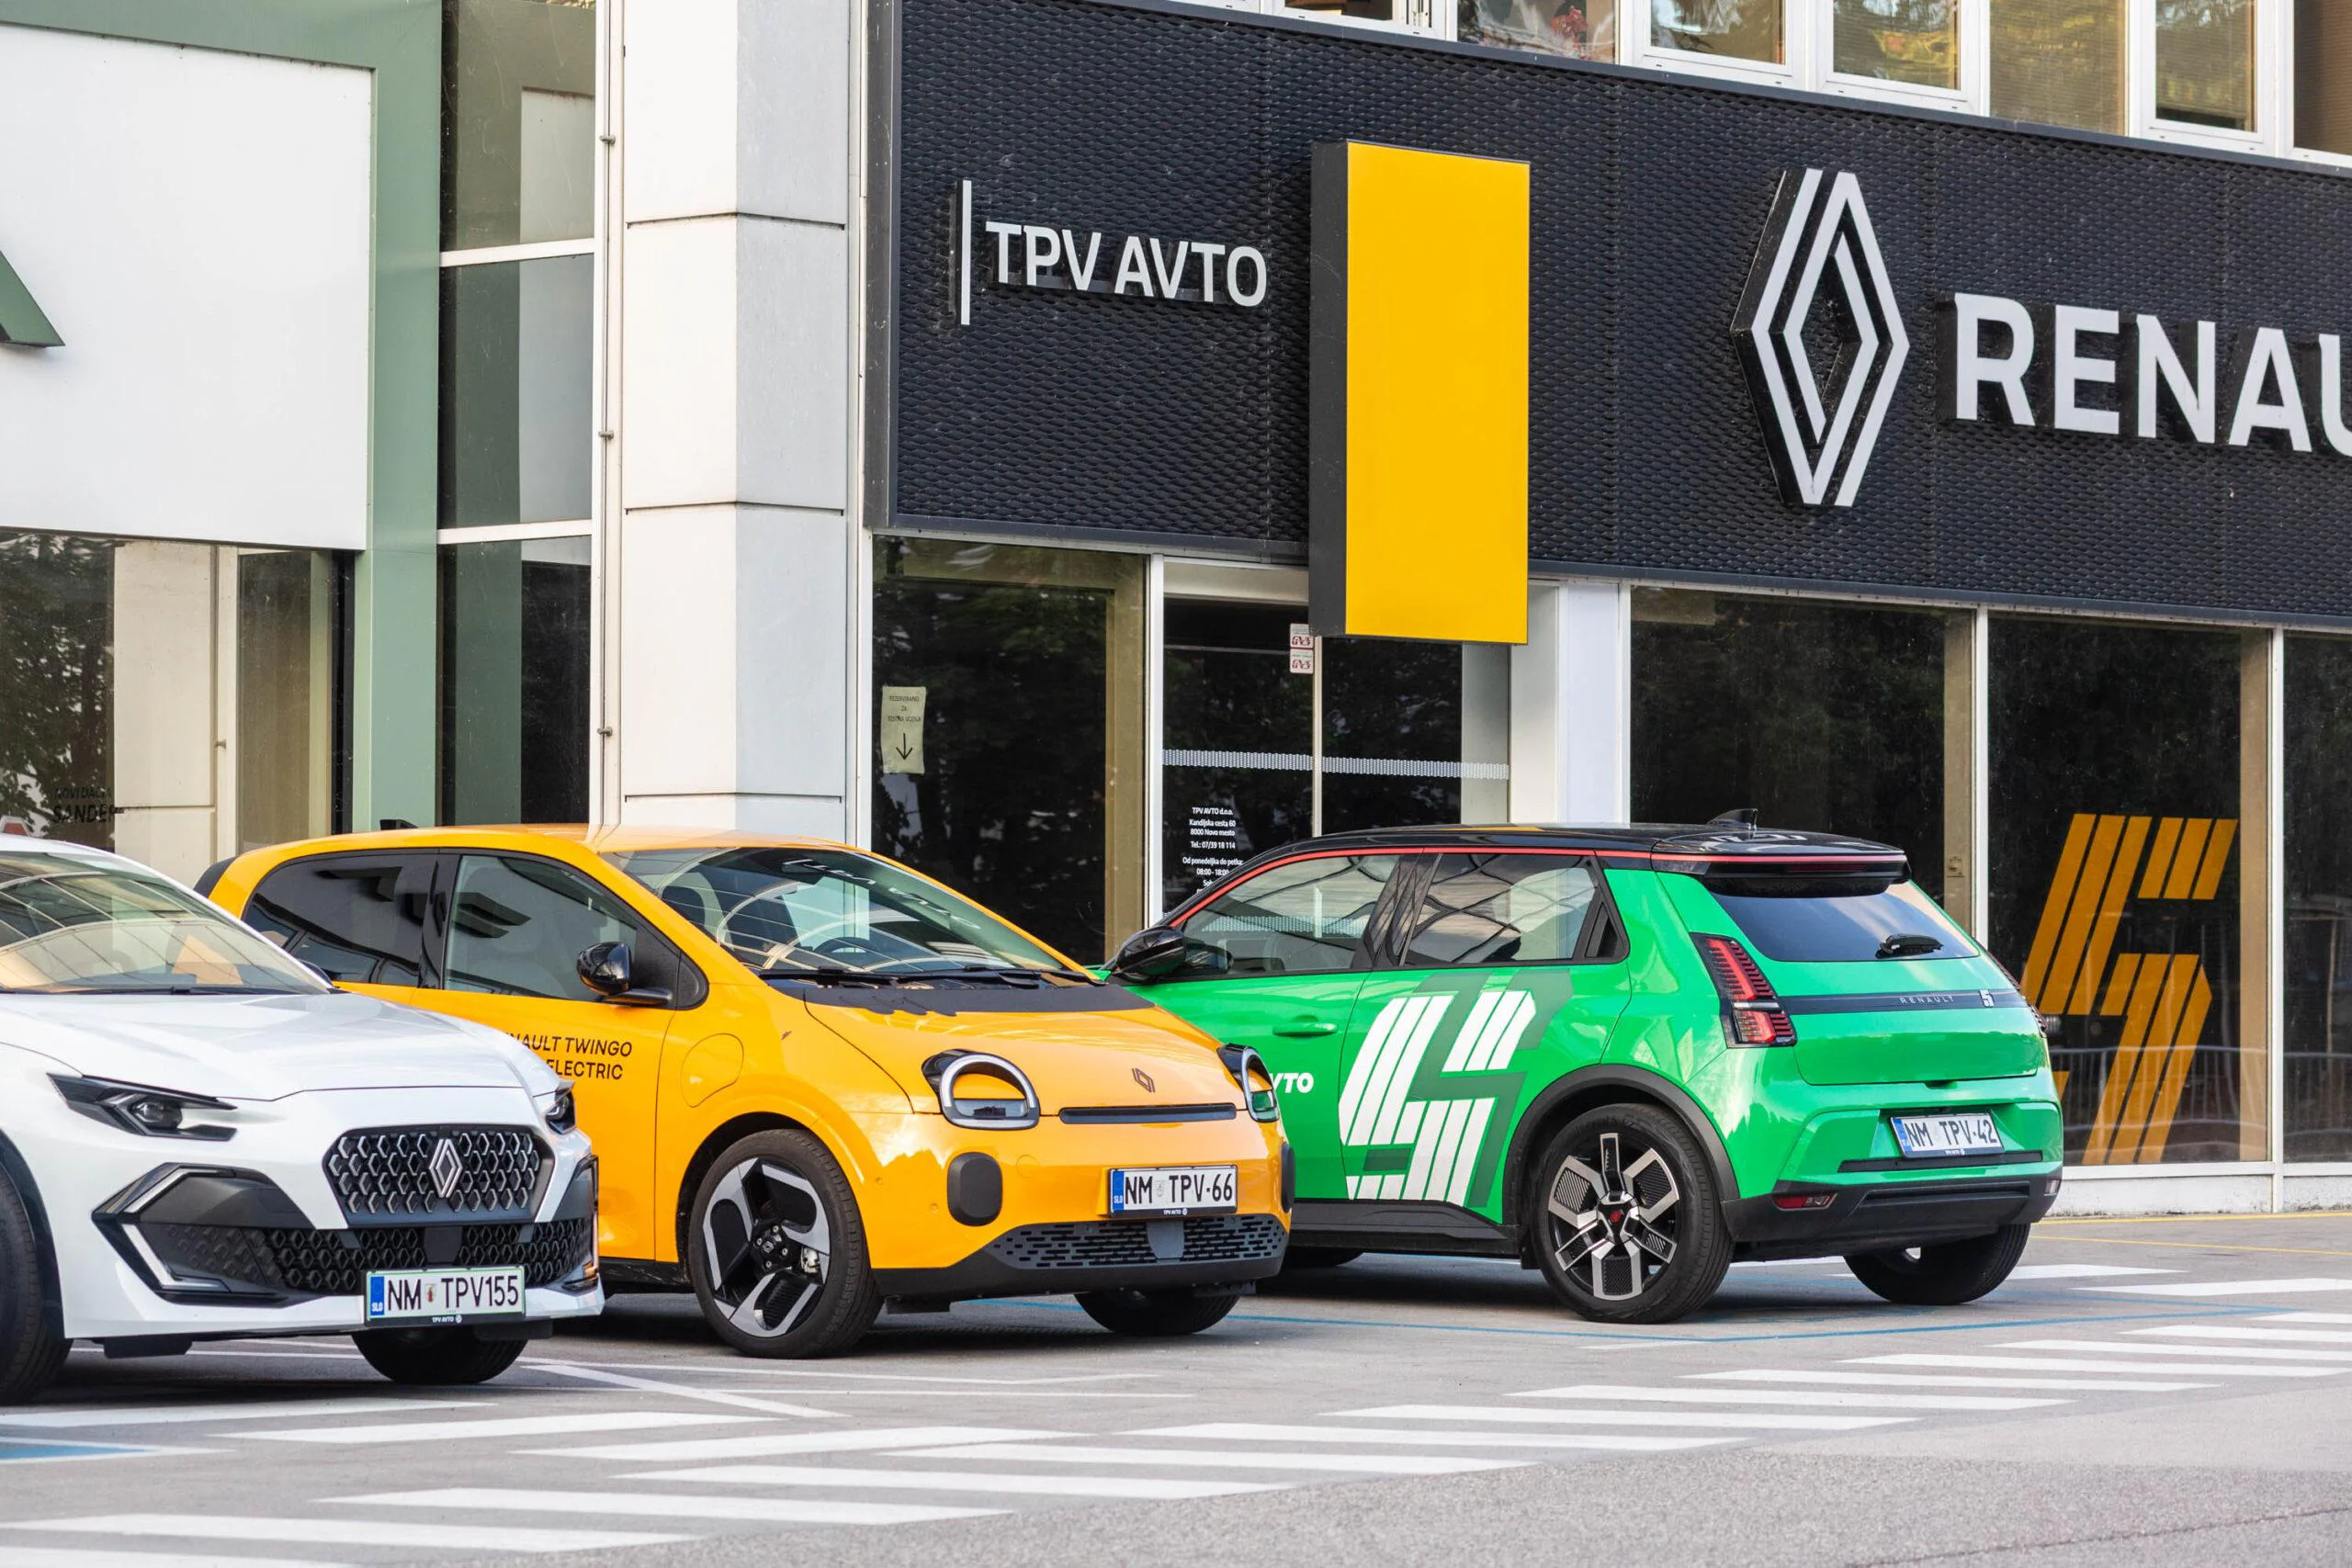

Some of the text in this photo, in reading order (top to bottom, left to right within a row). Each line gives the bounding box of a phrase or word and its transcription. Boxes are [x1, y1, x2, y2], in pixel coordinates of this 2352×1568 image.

[986, 221, 1267, 307] TPV AVTO
[1192, 807, 1204, 815] TPV
[1189, 818, 1215, 828] Kandijska
[1228, 819, 1237, 828] 60
[1190, 828, 1204, 836] 8000
[1182, 856, 1191, 864] Od
[1191, 856, 1220, 865] ponedeljka
[1899, 996, 1954, 1005] RENAULT
[564, 1037, 633, 1057] TWINGO
[1904, 1122, 1934, 1147] NM
[1125, 1176, 1153, 1204] NM
[371, 1275, 519, 1312] SLO NM TPV155
